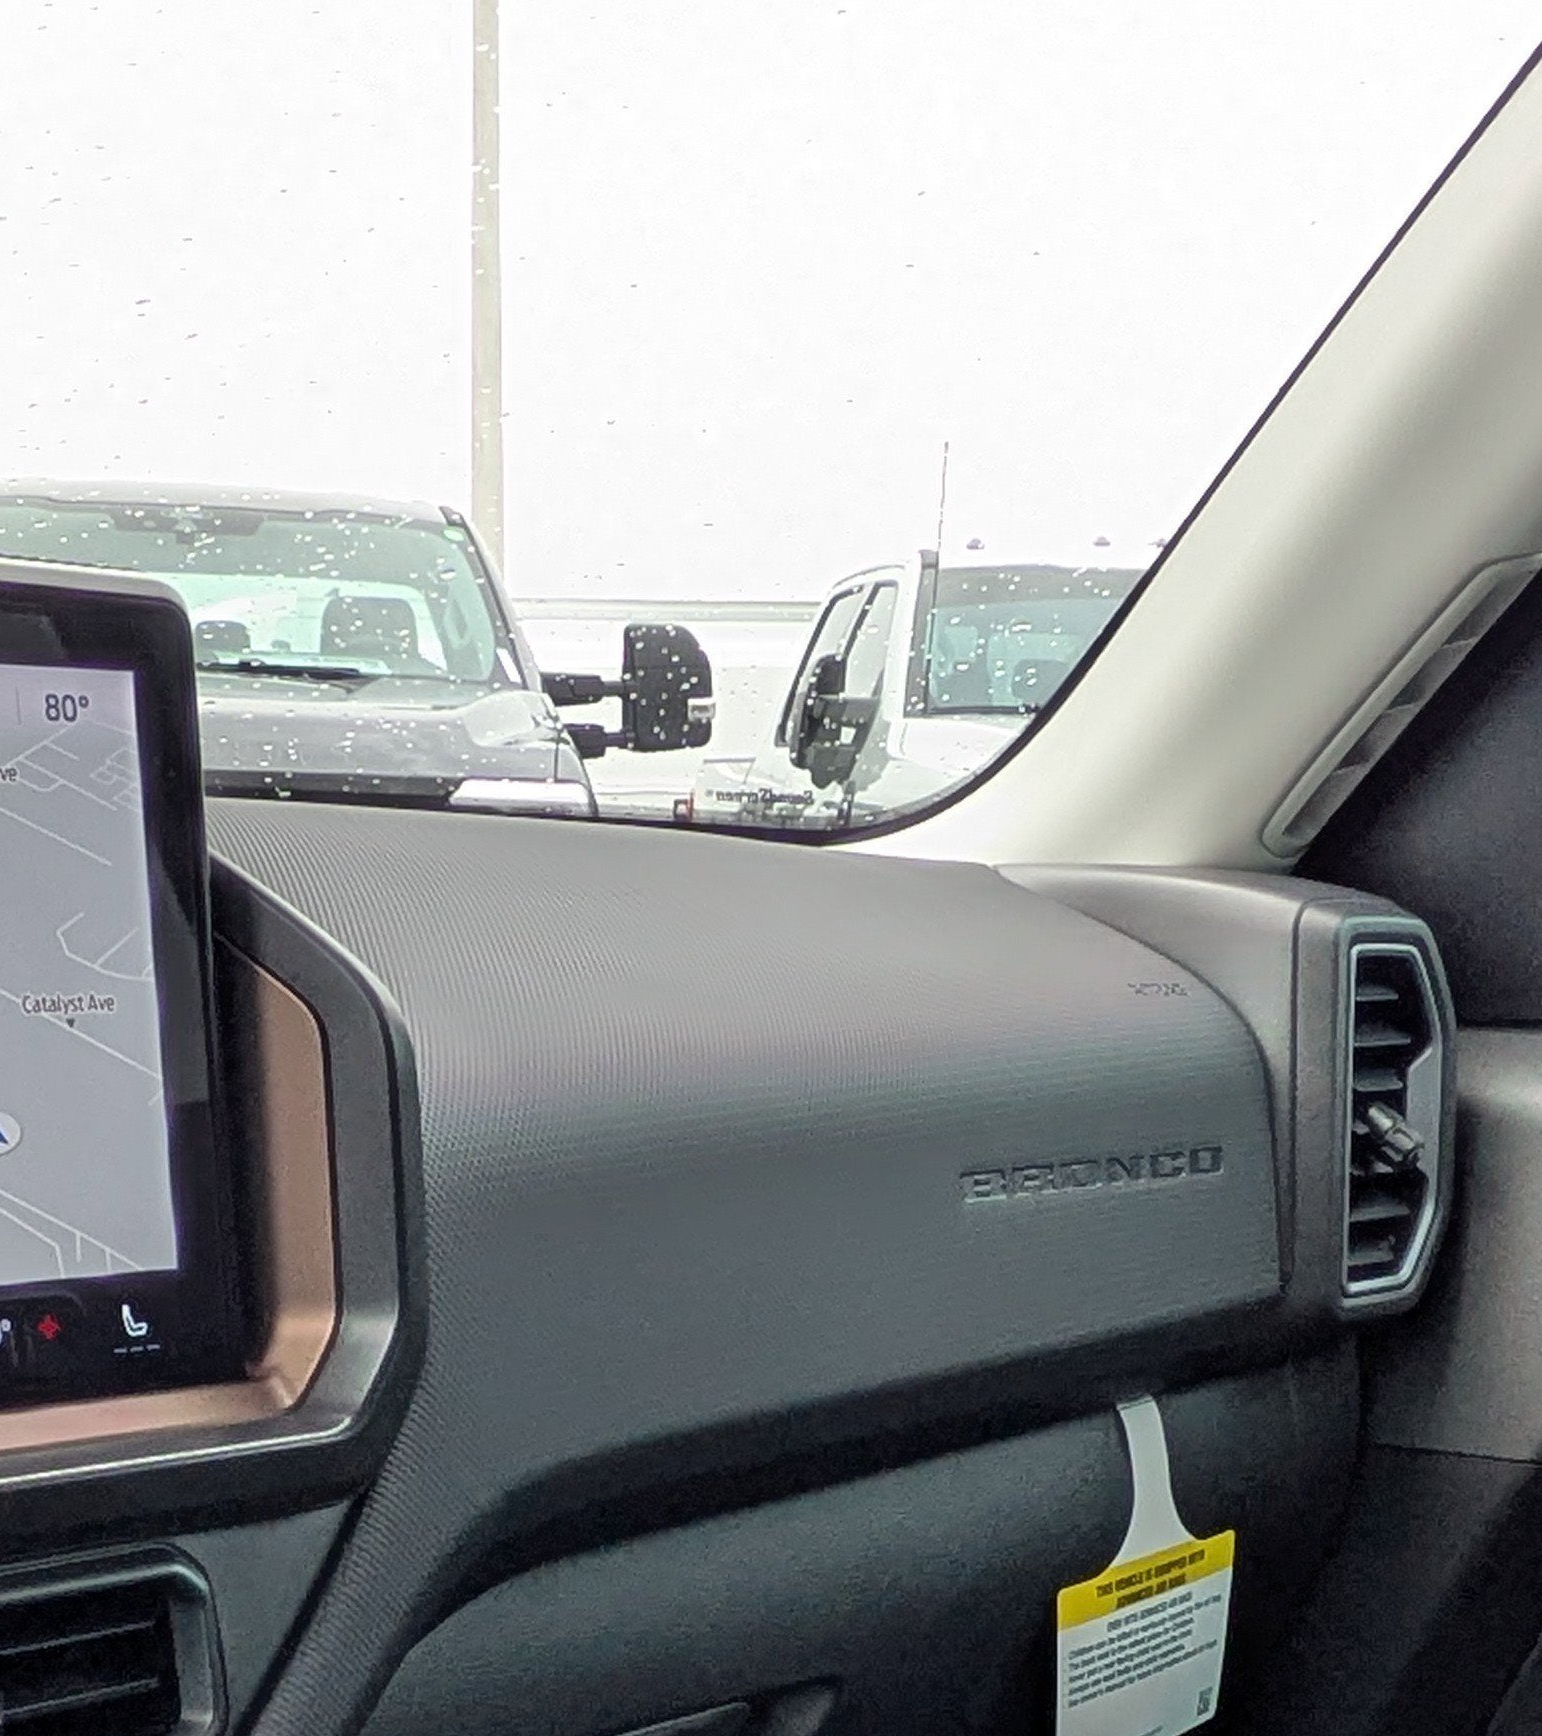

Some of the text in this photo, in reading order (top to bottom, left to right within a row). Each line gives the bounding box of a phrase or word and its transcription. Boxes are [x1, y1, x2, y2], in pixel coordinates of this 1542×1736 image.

[44, 693, 90, 722] 80°
[22, 991, 116, 1015] Catalyst Ave
[960, 1145, 1224, 1203] BRONCO
